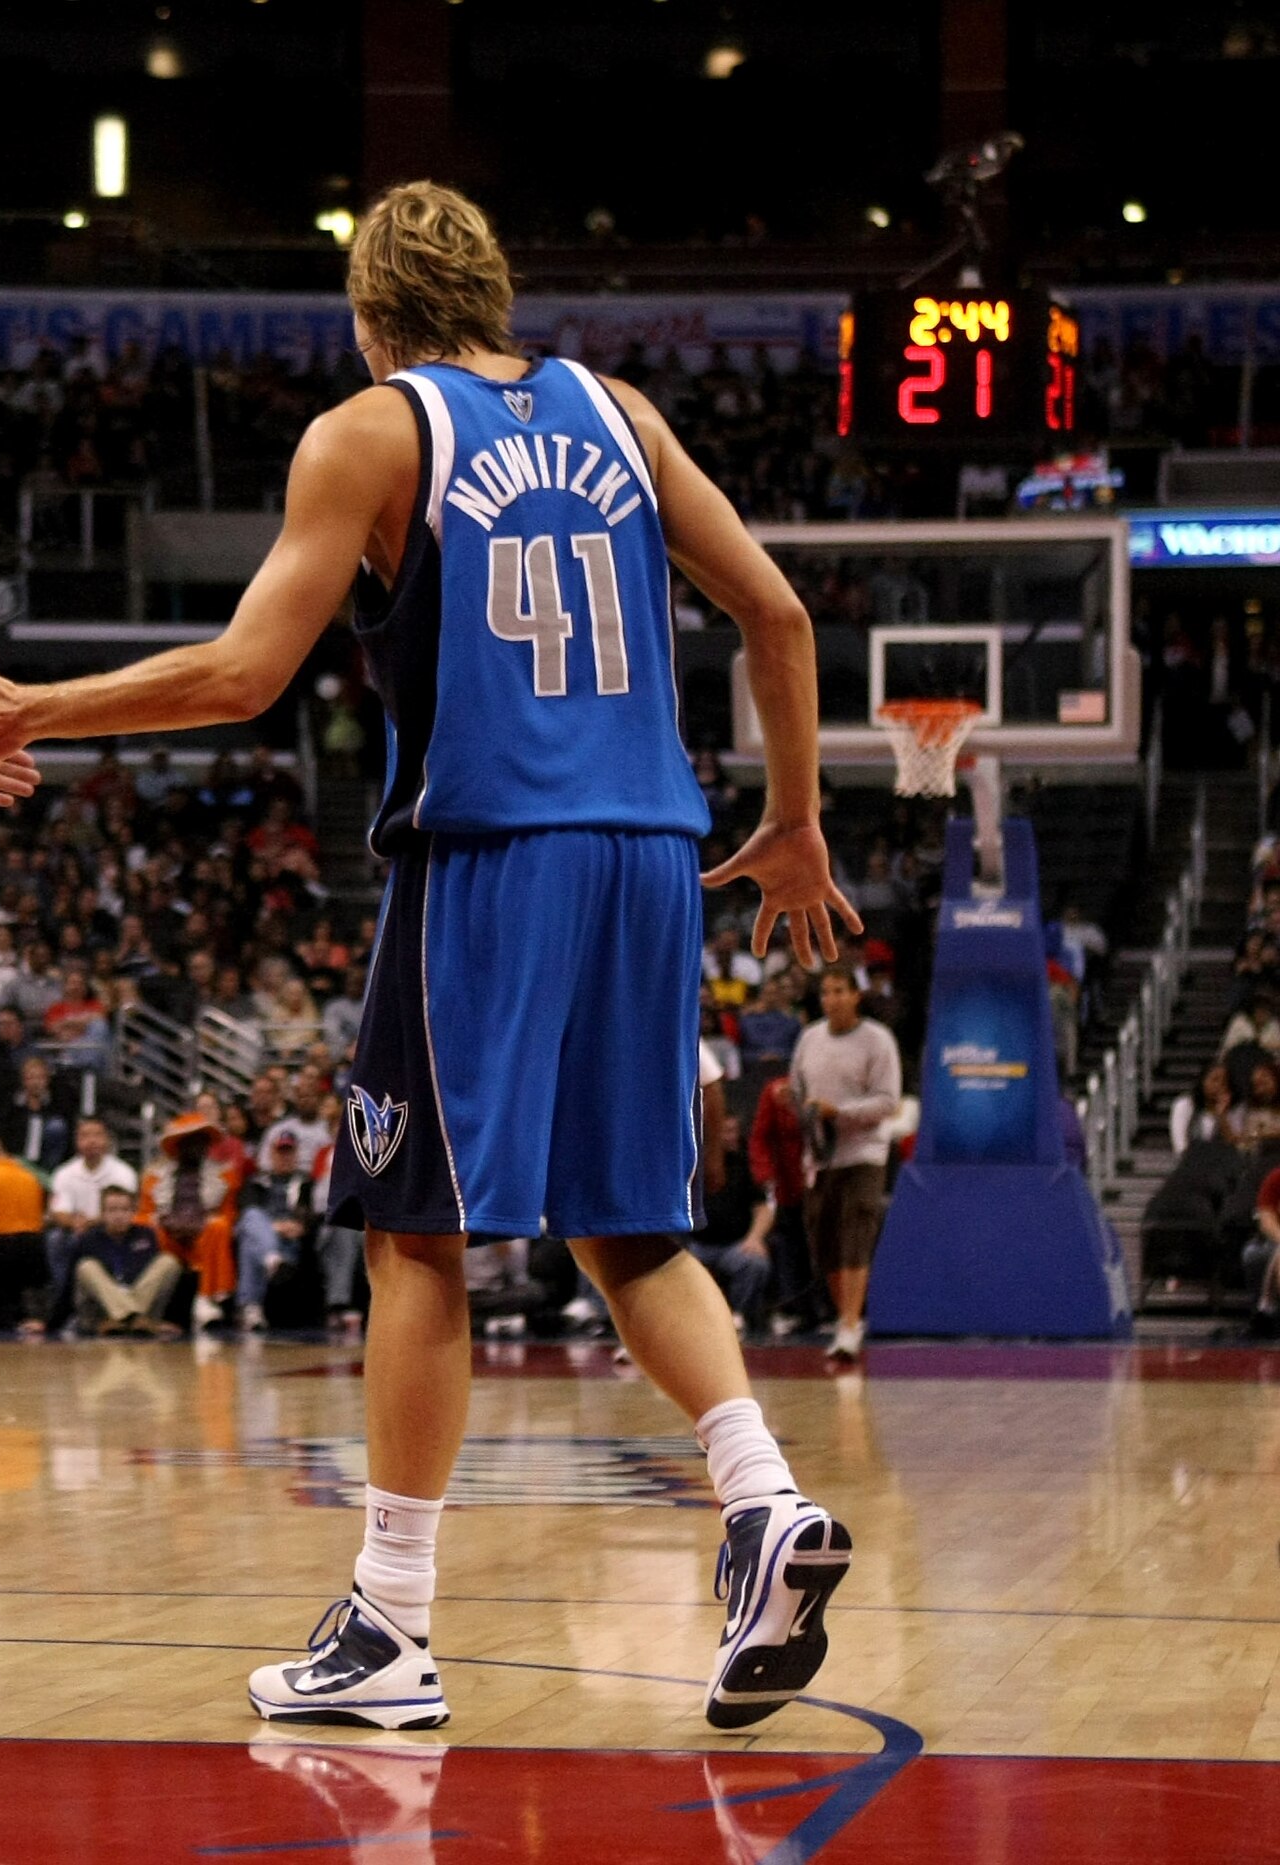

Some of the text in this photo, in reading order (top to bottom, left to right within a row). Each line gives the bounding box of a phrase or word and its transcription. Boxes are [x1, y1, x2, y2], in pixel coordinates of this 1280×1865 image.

[909, 297, 1010, 346] 2:44
[897, 344, 993, 424] 21
[445, 434, 642, 532] NOWITZKI
[486, 532, 630, 697] 41
